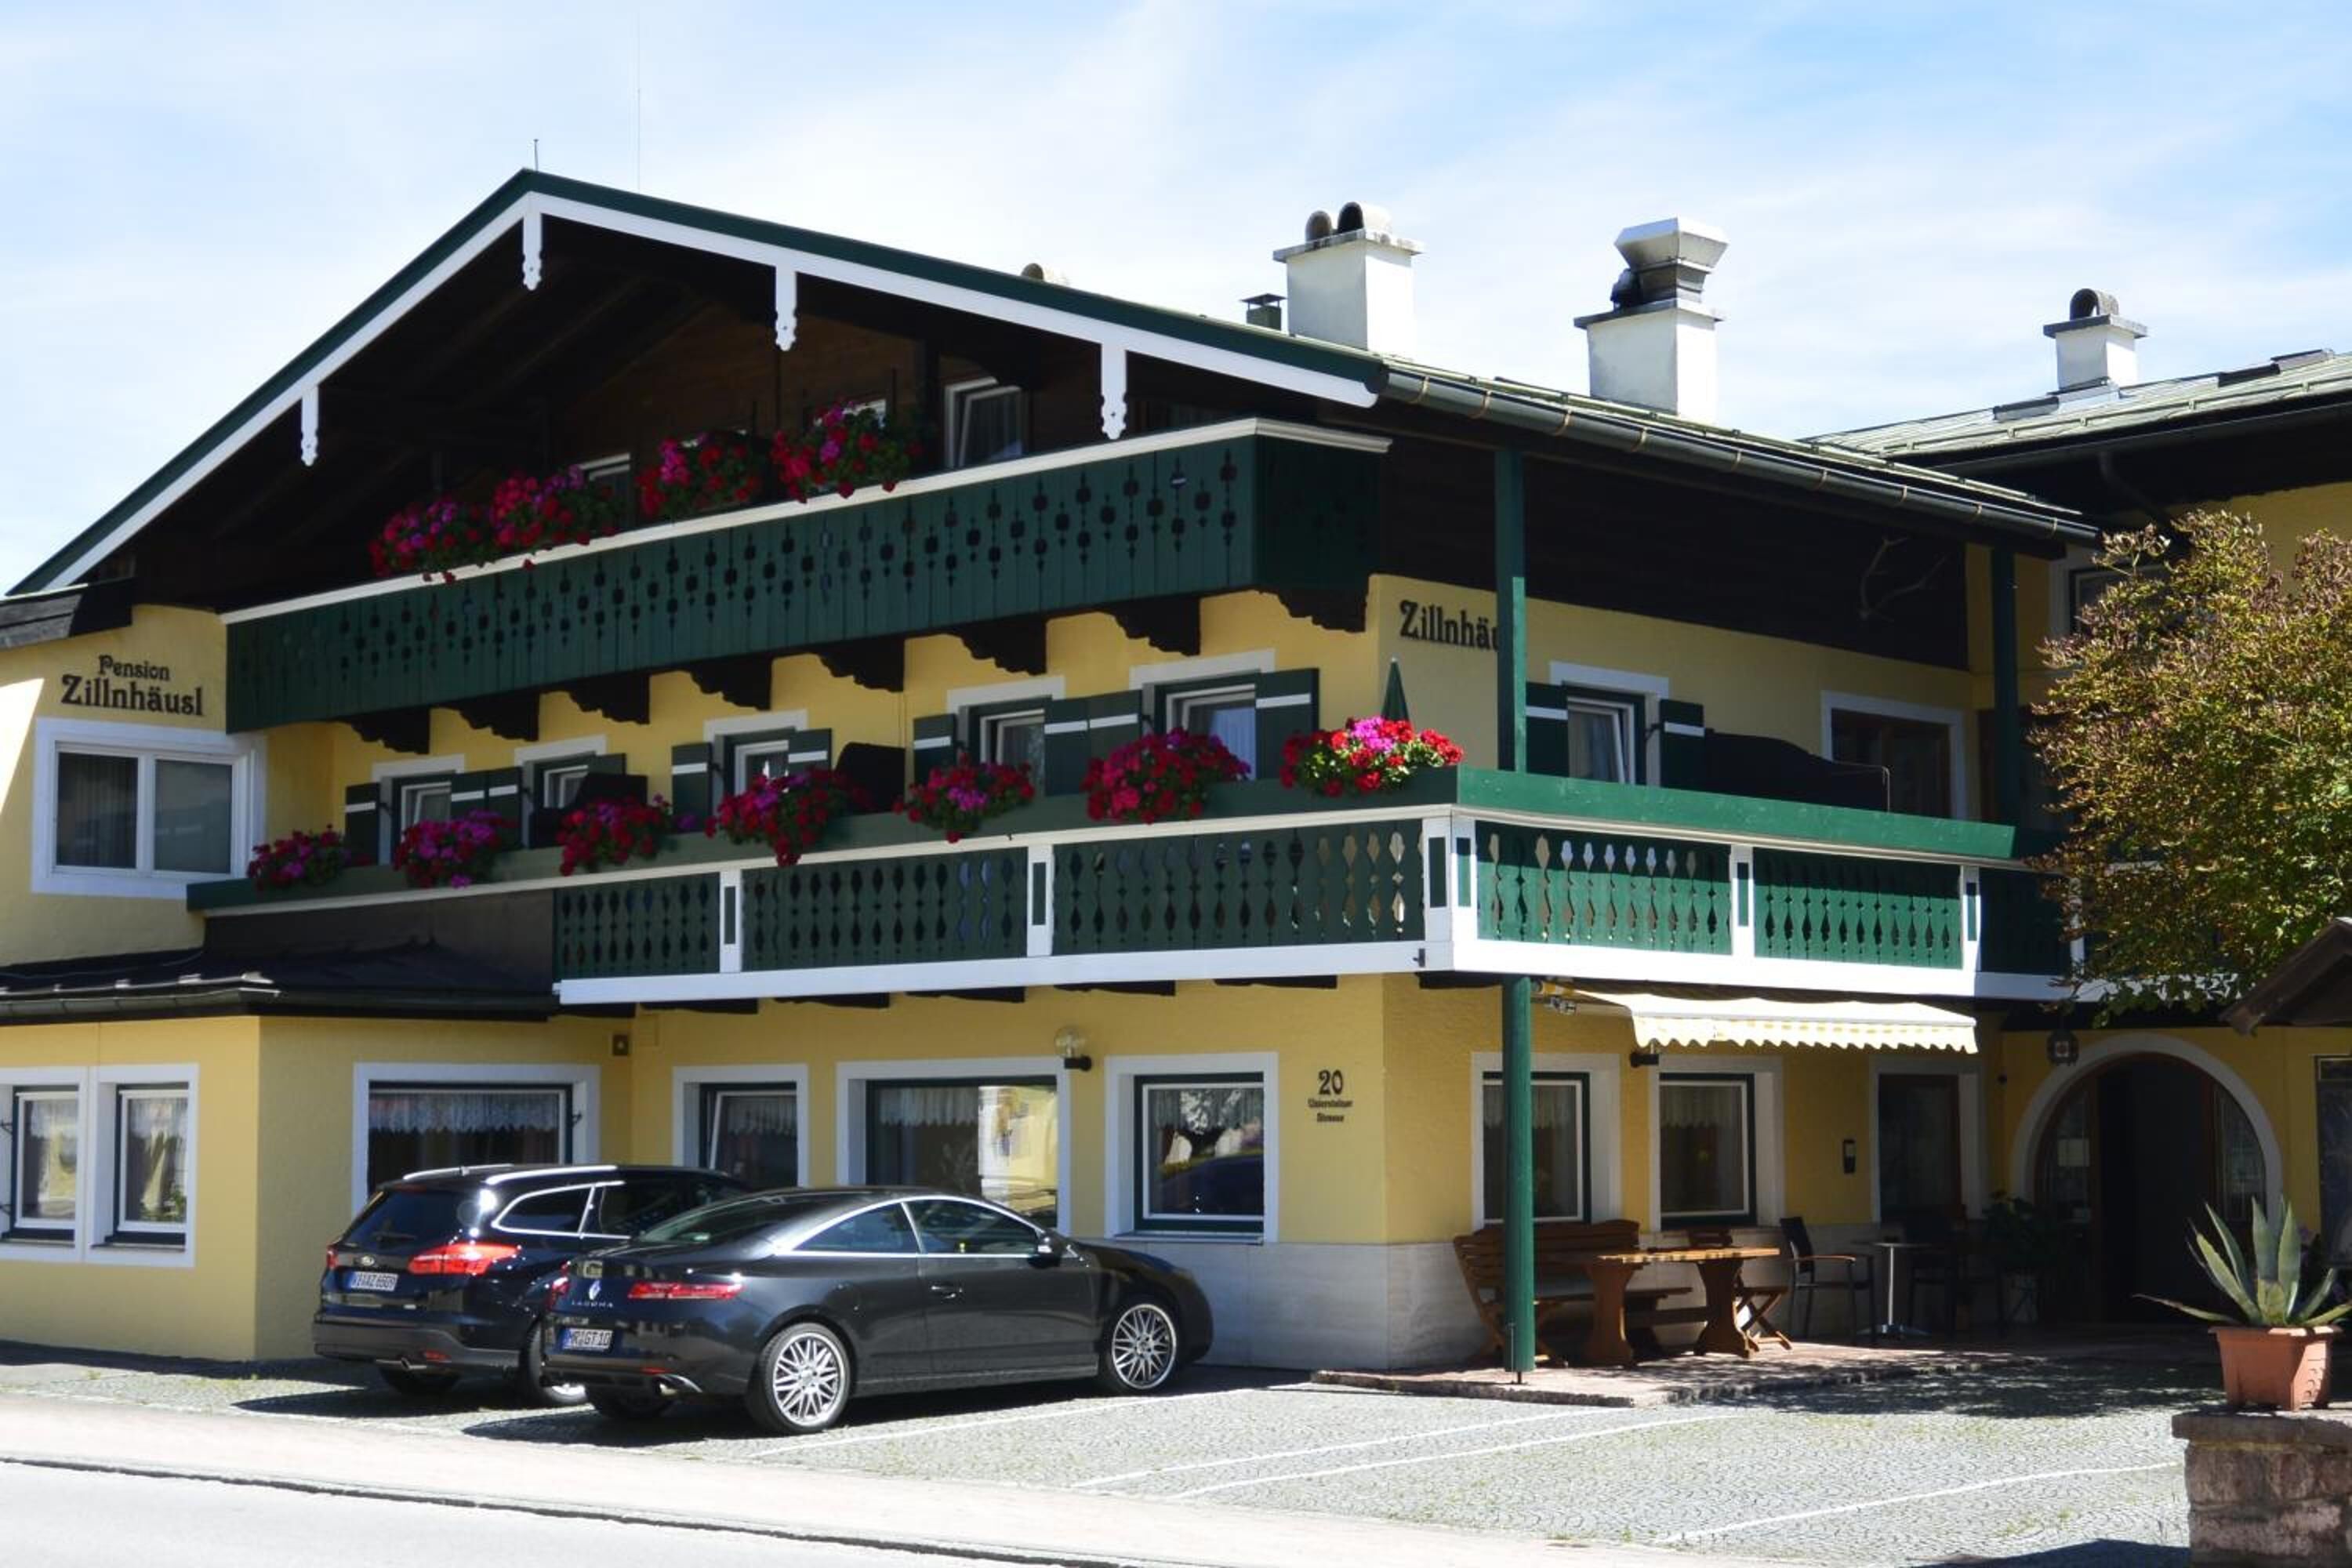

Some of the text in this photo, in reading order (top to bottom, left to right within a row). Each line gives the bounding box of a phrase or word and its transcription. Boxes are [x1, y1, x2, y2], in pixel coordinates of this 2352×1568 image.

[99, 655, 170, 681] Pension
[61, 674, 204, 717] Zillnhäusl
[1318, 1069, 1343, 1095] 20
